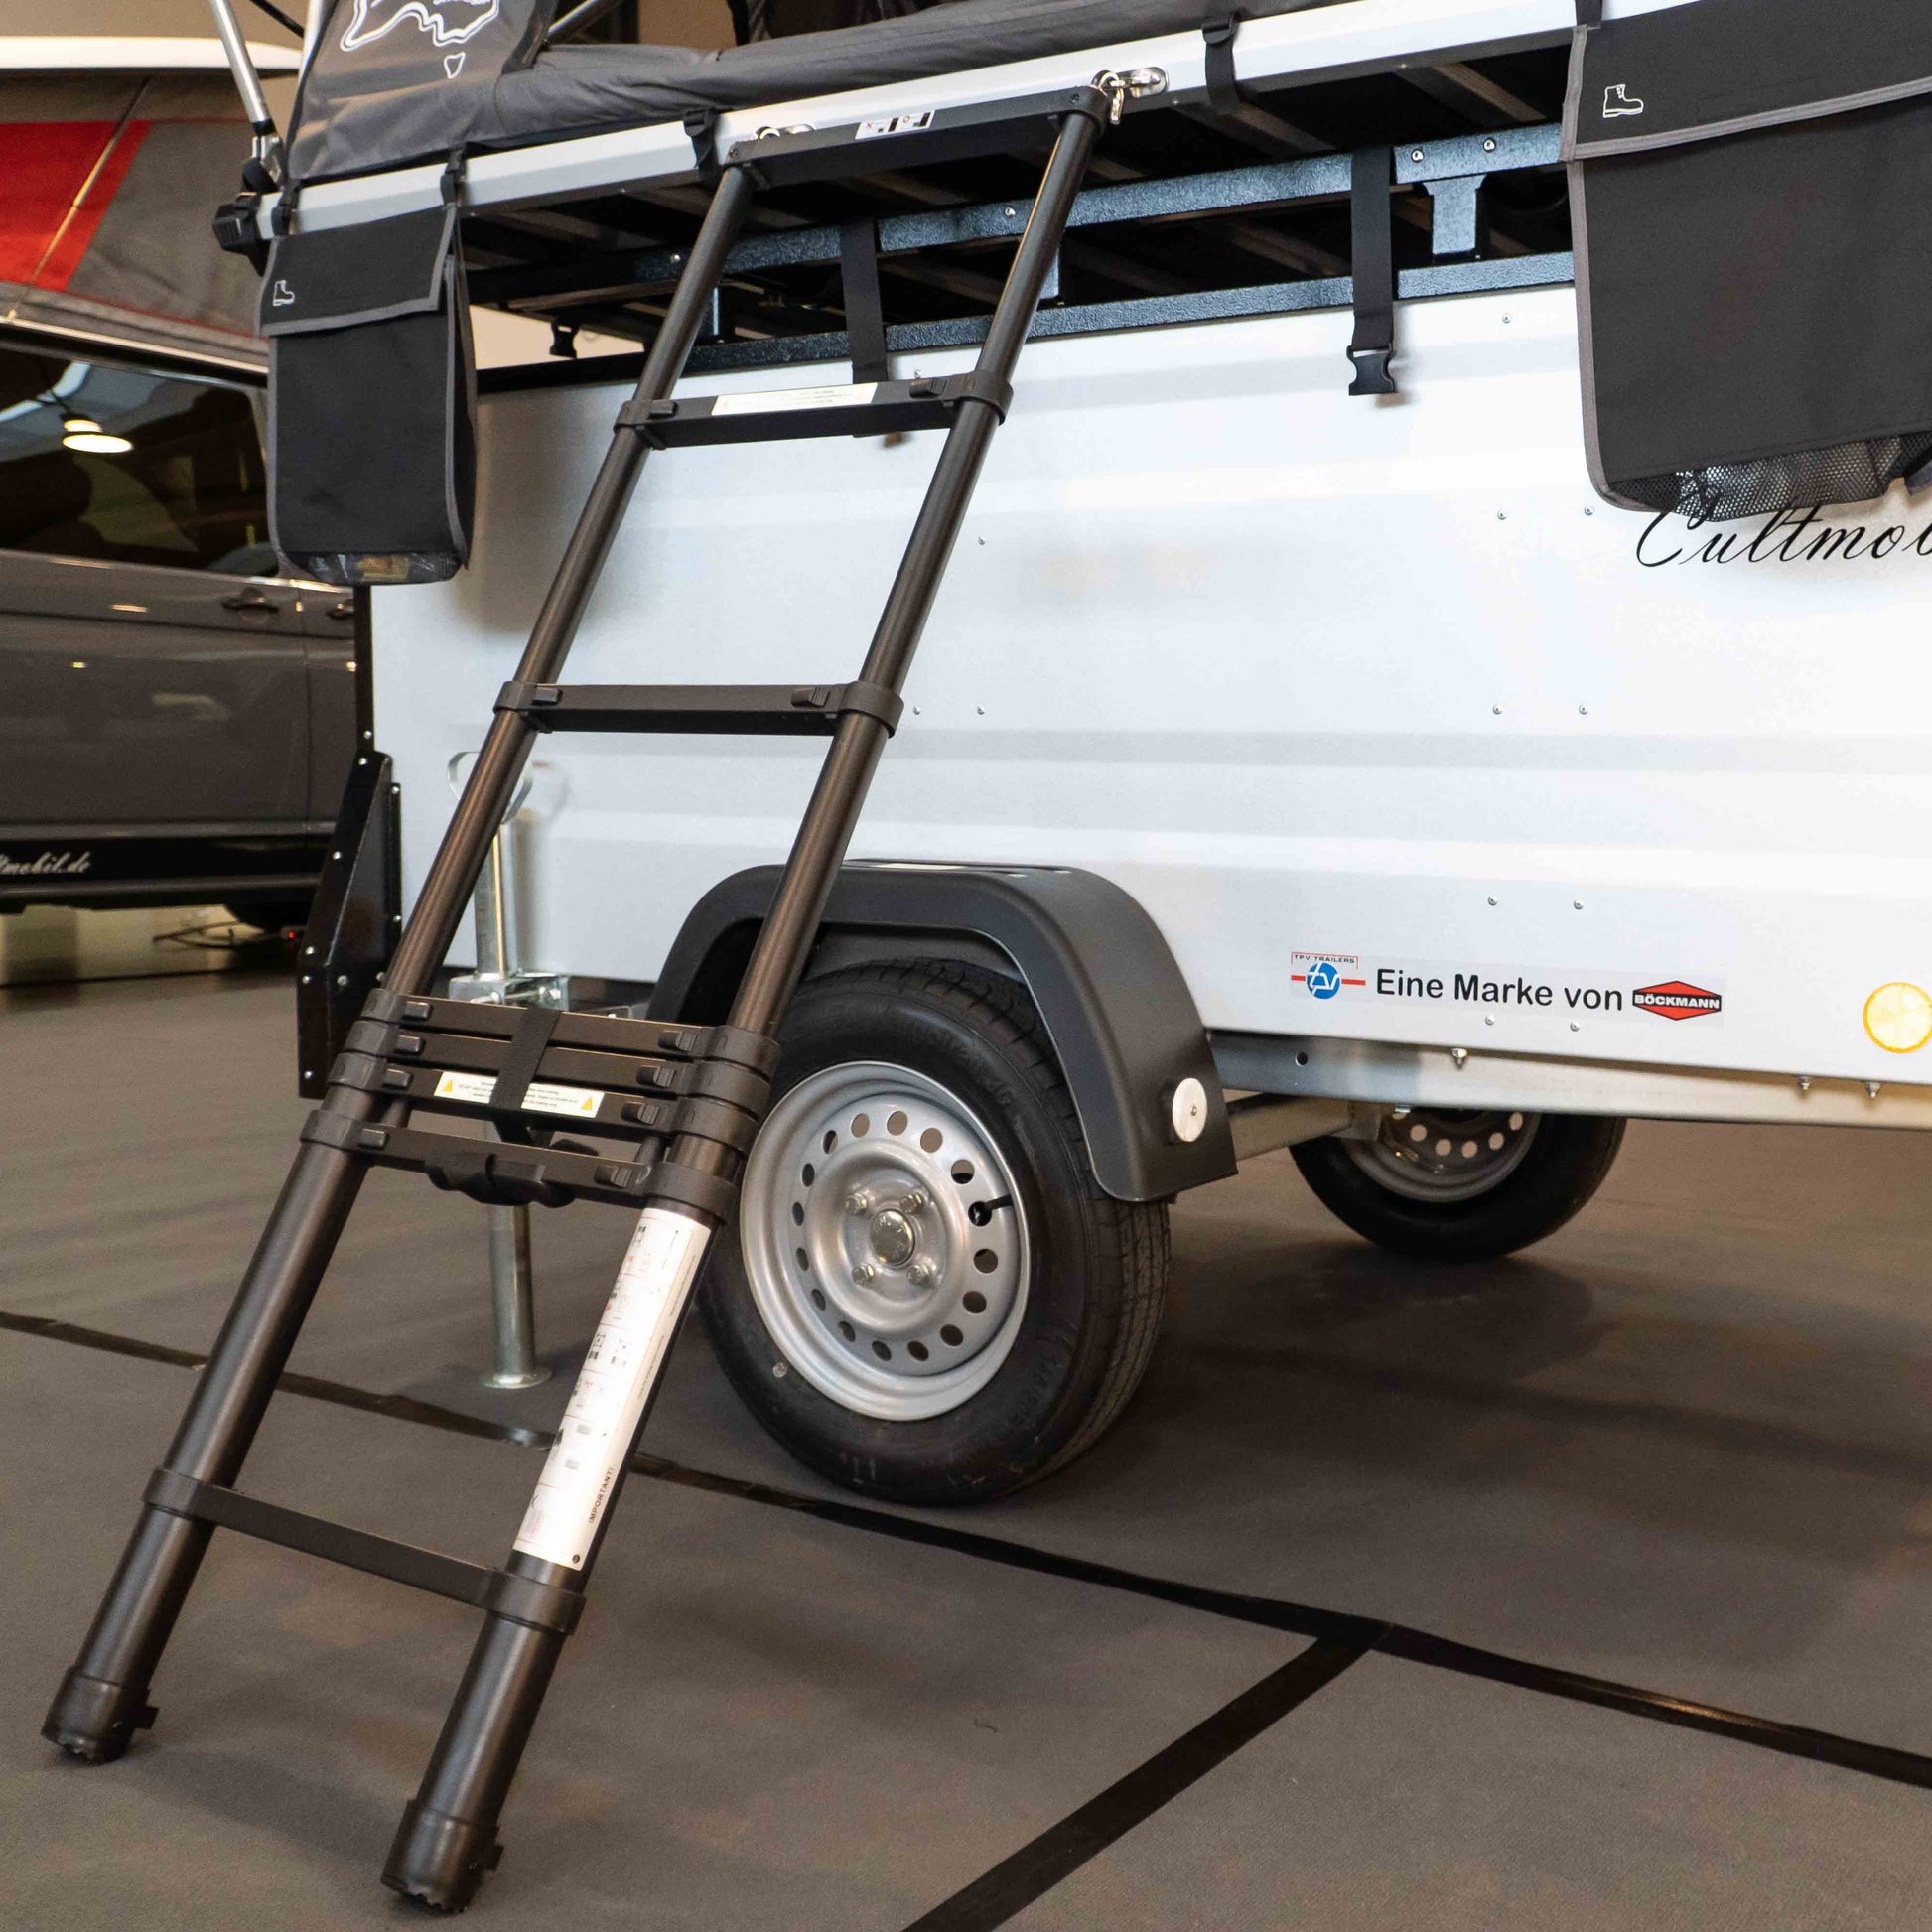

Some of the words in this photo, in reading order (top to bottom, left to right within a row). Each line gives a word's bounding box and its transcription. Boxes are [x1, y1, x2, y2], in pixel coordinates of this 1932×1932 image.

[1376, 968, 1444, 999] Eine
[1454, 973, 1553, 1006] Marke
[1564, 987, 1623, 1011] von
[1633, 993, 1721, 1010] BÖCKMANN
